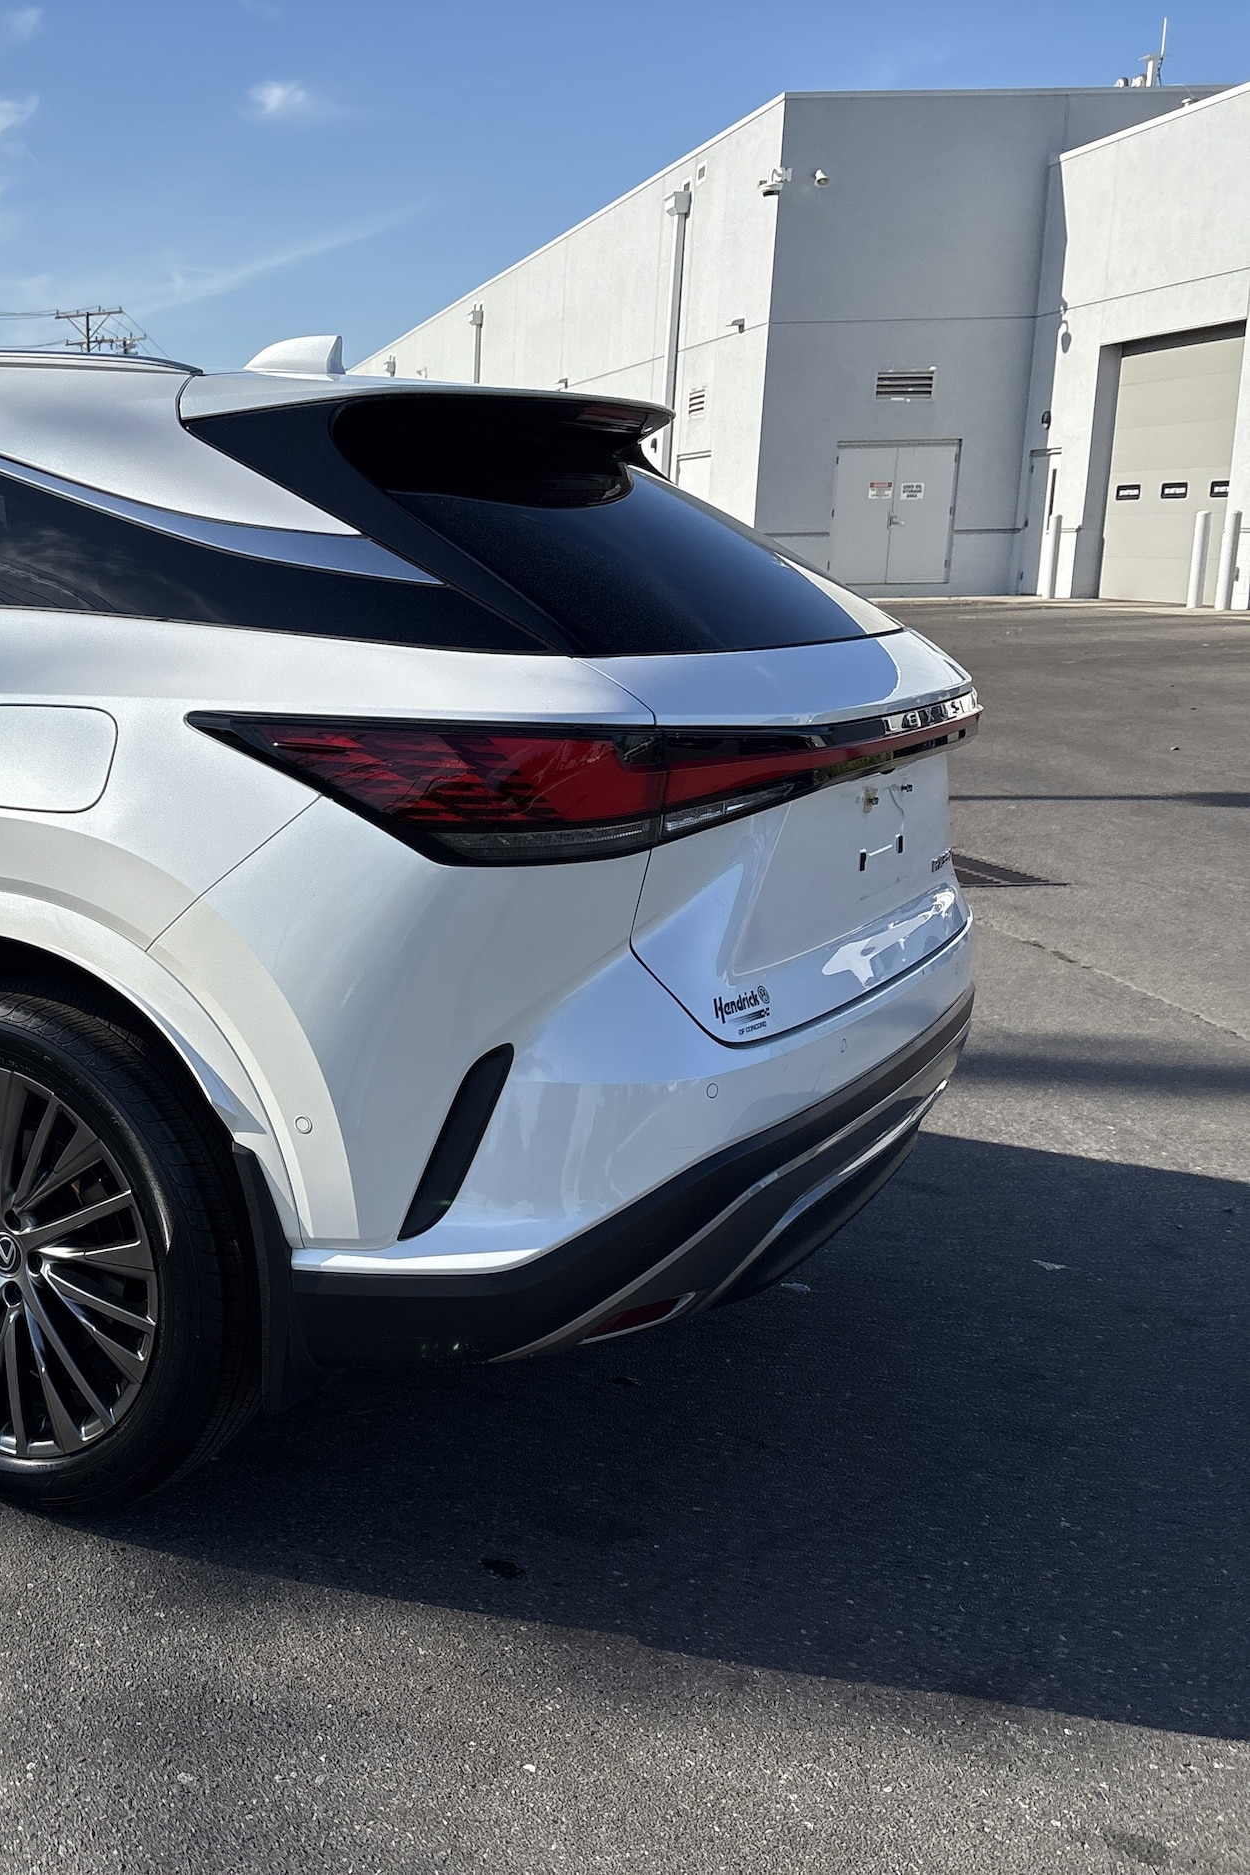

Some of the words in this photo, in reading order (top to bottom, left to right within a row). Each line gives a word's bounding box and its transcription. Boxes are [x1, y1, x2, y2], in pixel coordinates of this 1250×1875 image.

[884, 701, 960, 732] LEXUS
[713, 990, 760, 1024] Hendrick
[738, 1028, 745, 1036] OF
[745, 1021, 767, 1033] CONCORD
